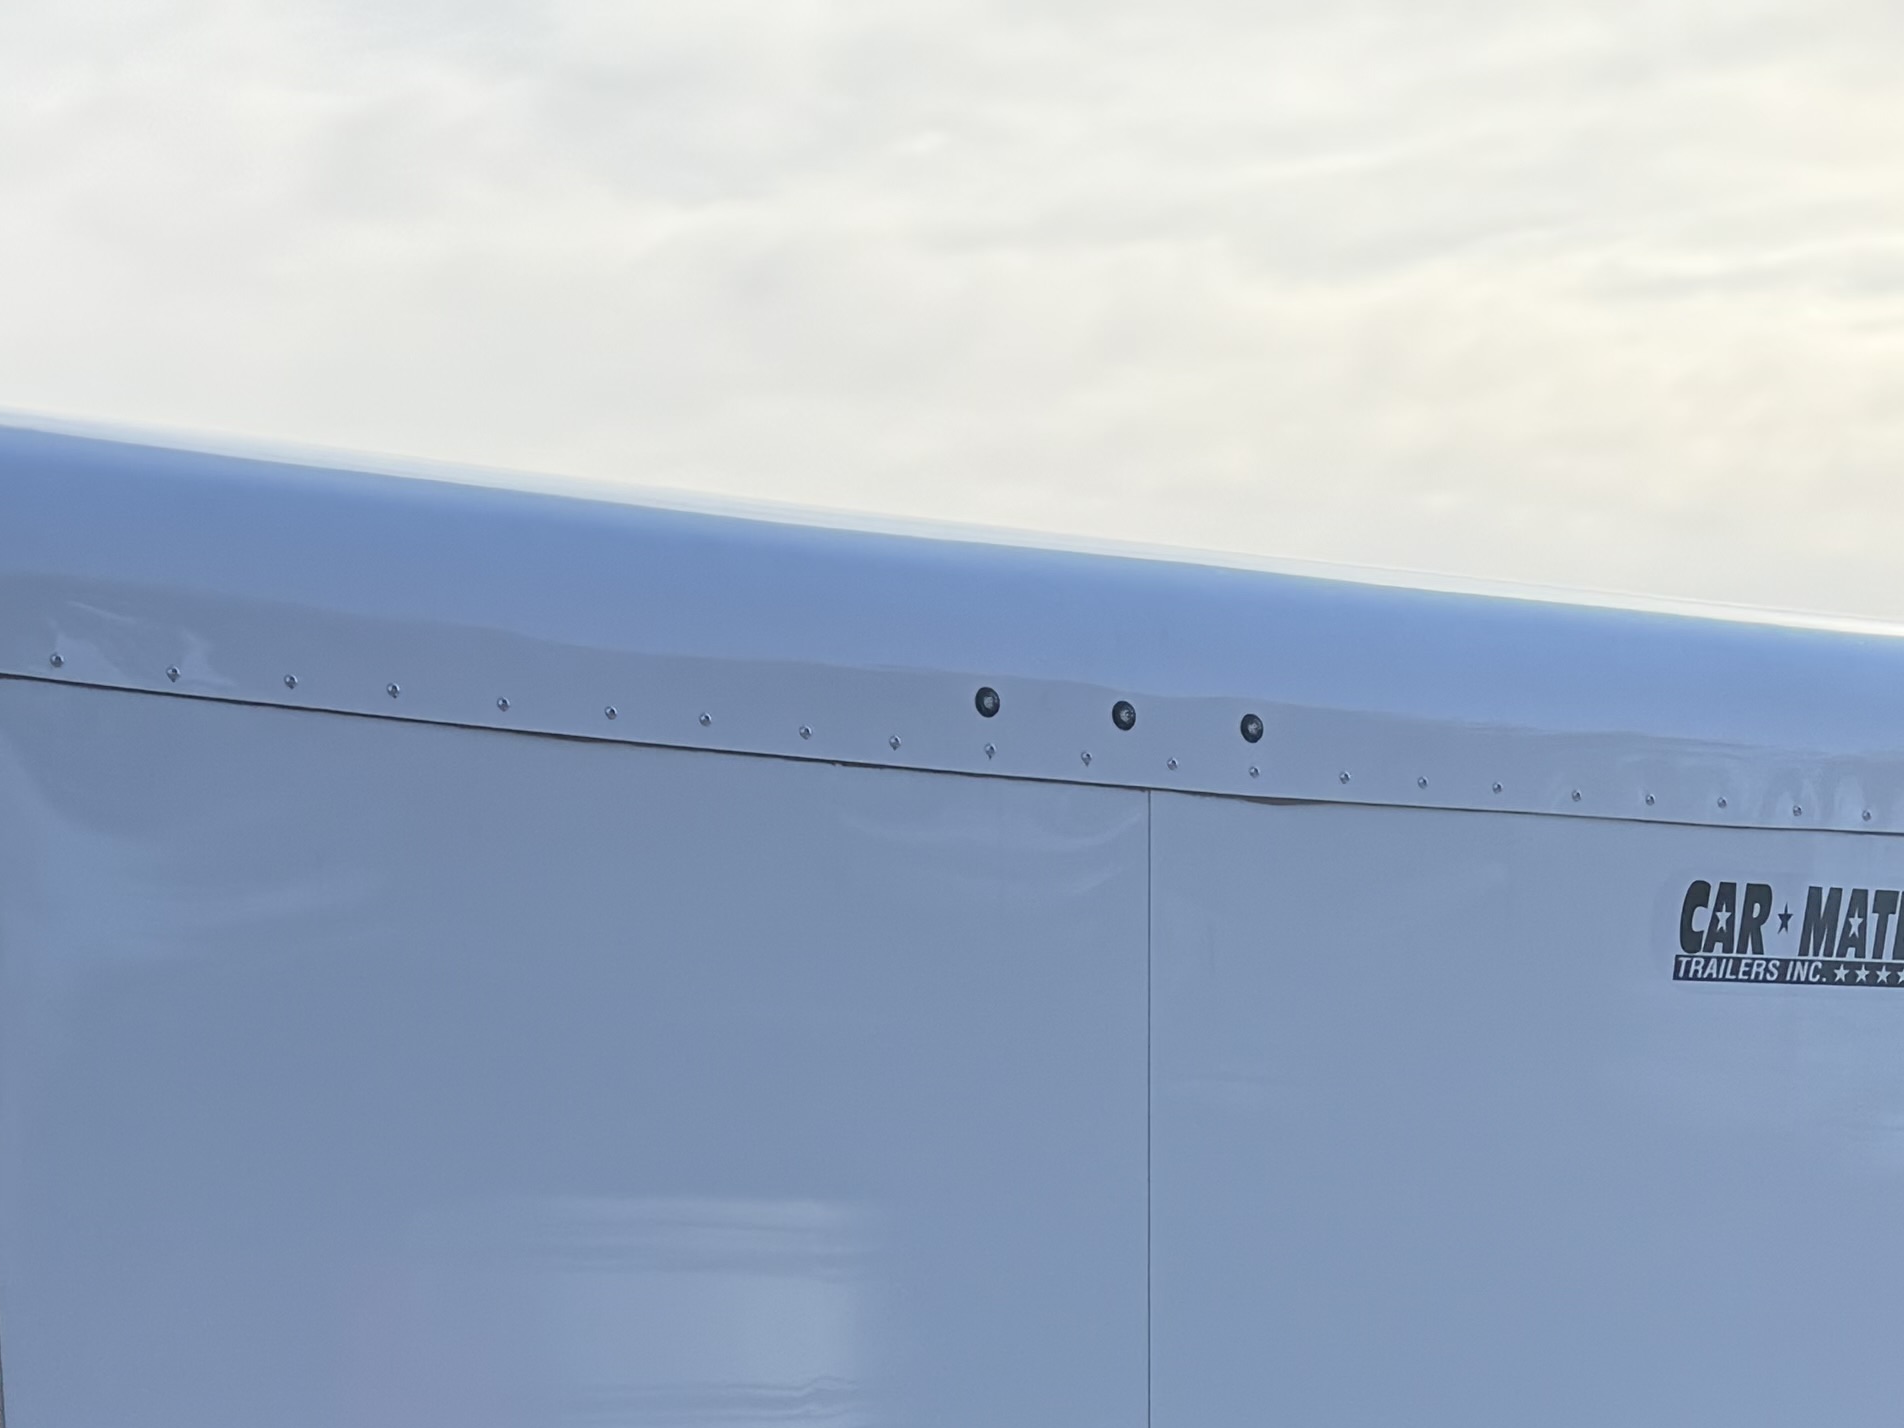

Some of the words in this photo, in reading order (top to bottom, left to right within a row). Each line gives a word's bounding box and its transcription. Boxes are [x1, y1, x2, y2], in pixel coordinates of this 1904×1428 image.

[1679, 880, 1772, 955] CAR
[1678, 957, 1780, 981] TRAILERS
[1786, 961, 1827, 982] INC.
